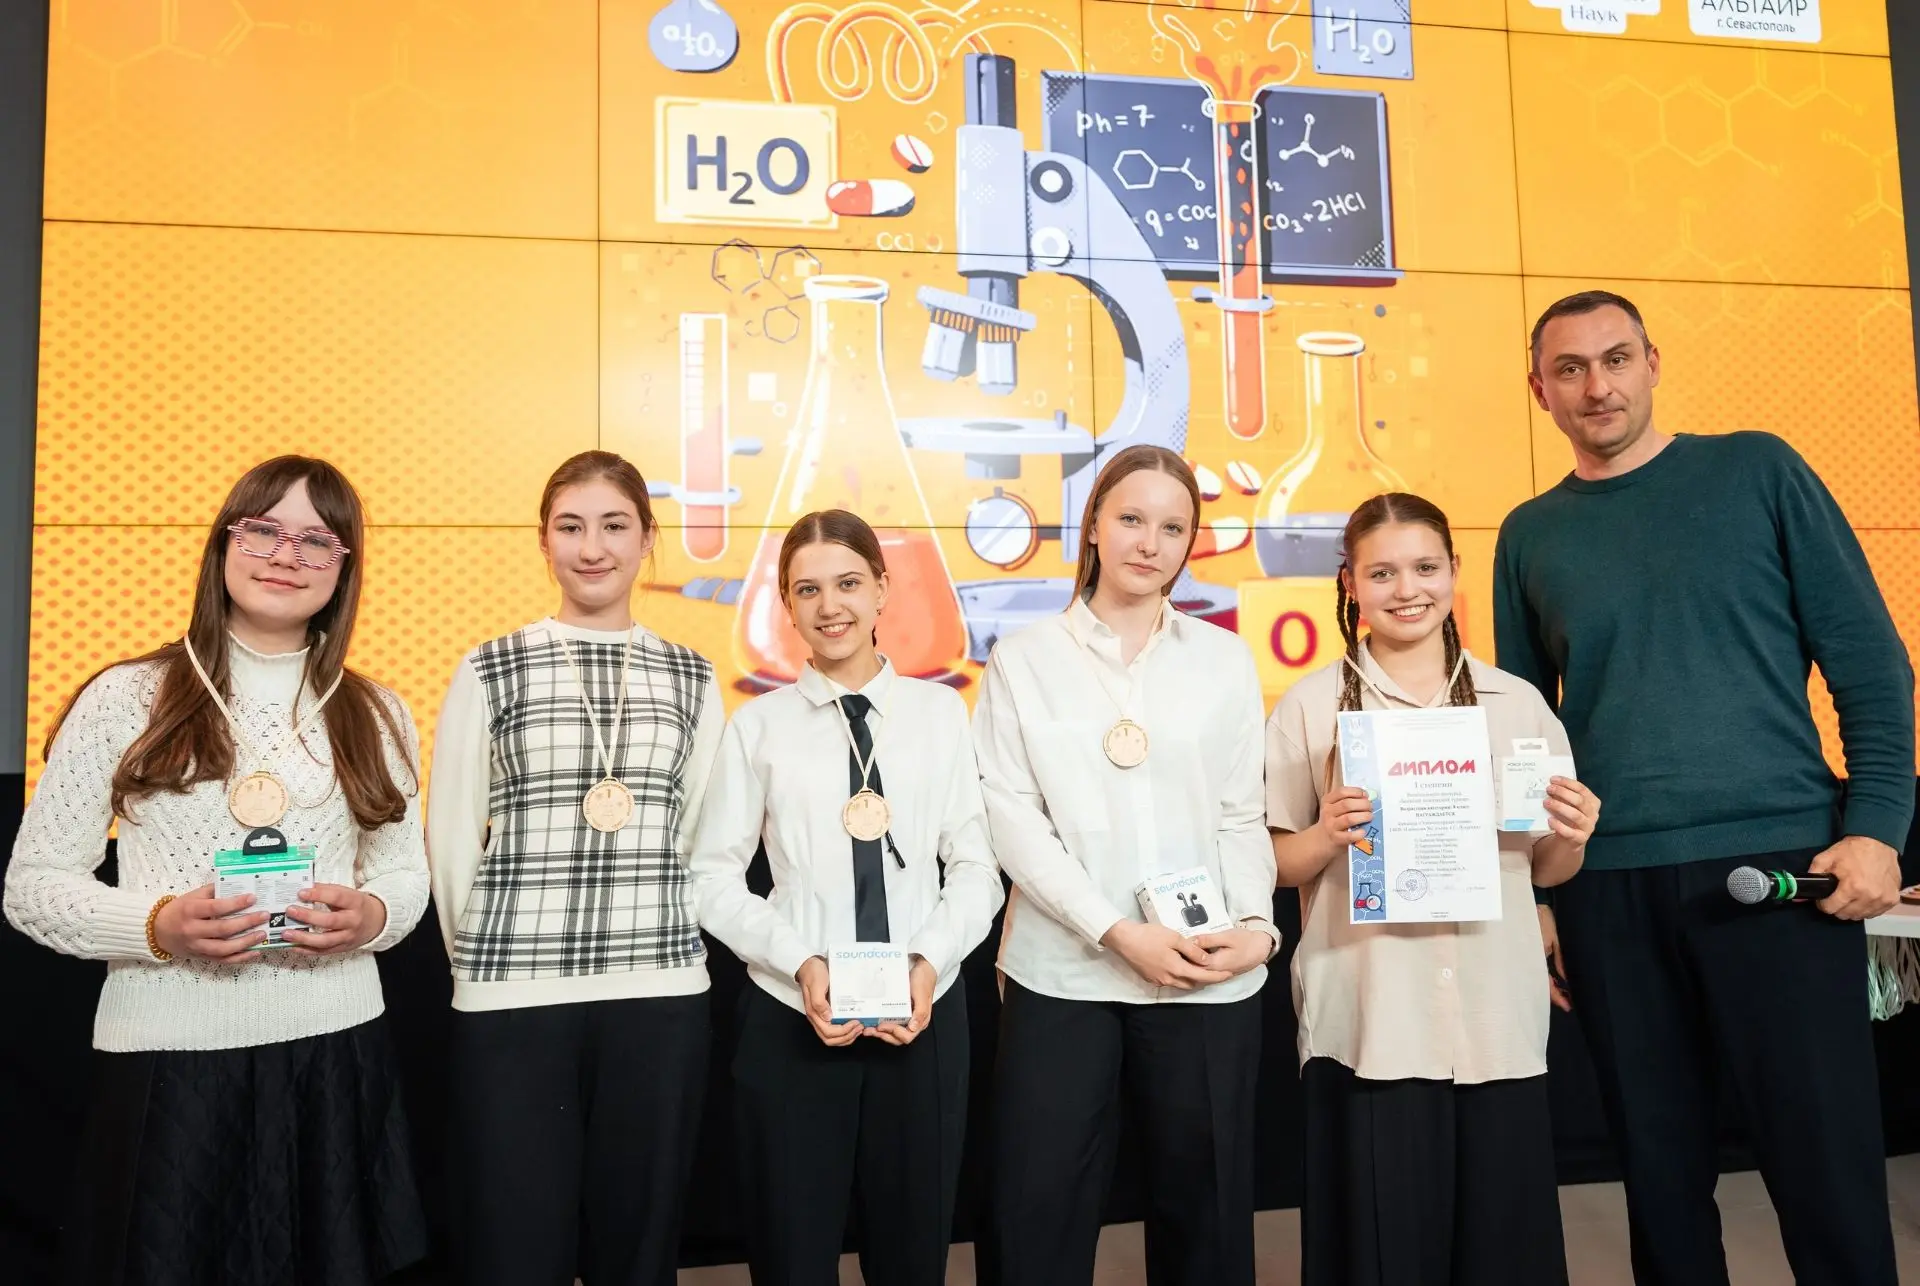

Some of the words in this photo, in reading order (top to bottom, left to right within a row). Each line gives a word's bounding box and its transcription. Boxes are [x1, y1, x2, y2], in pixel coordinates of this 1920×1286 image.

[1570, 4, 1618, 23] Наук
[1726, 17, 1796, 32] Севастополь
[1387, 759, 1477, 776] ДИПЛОМ
[1153, 873, 1207, 896] soundcore
[835, 949, 902, 959] soundcore
